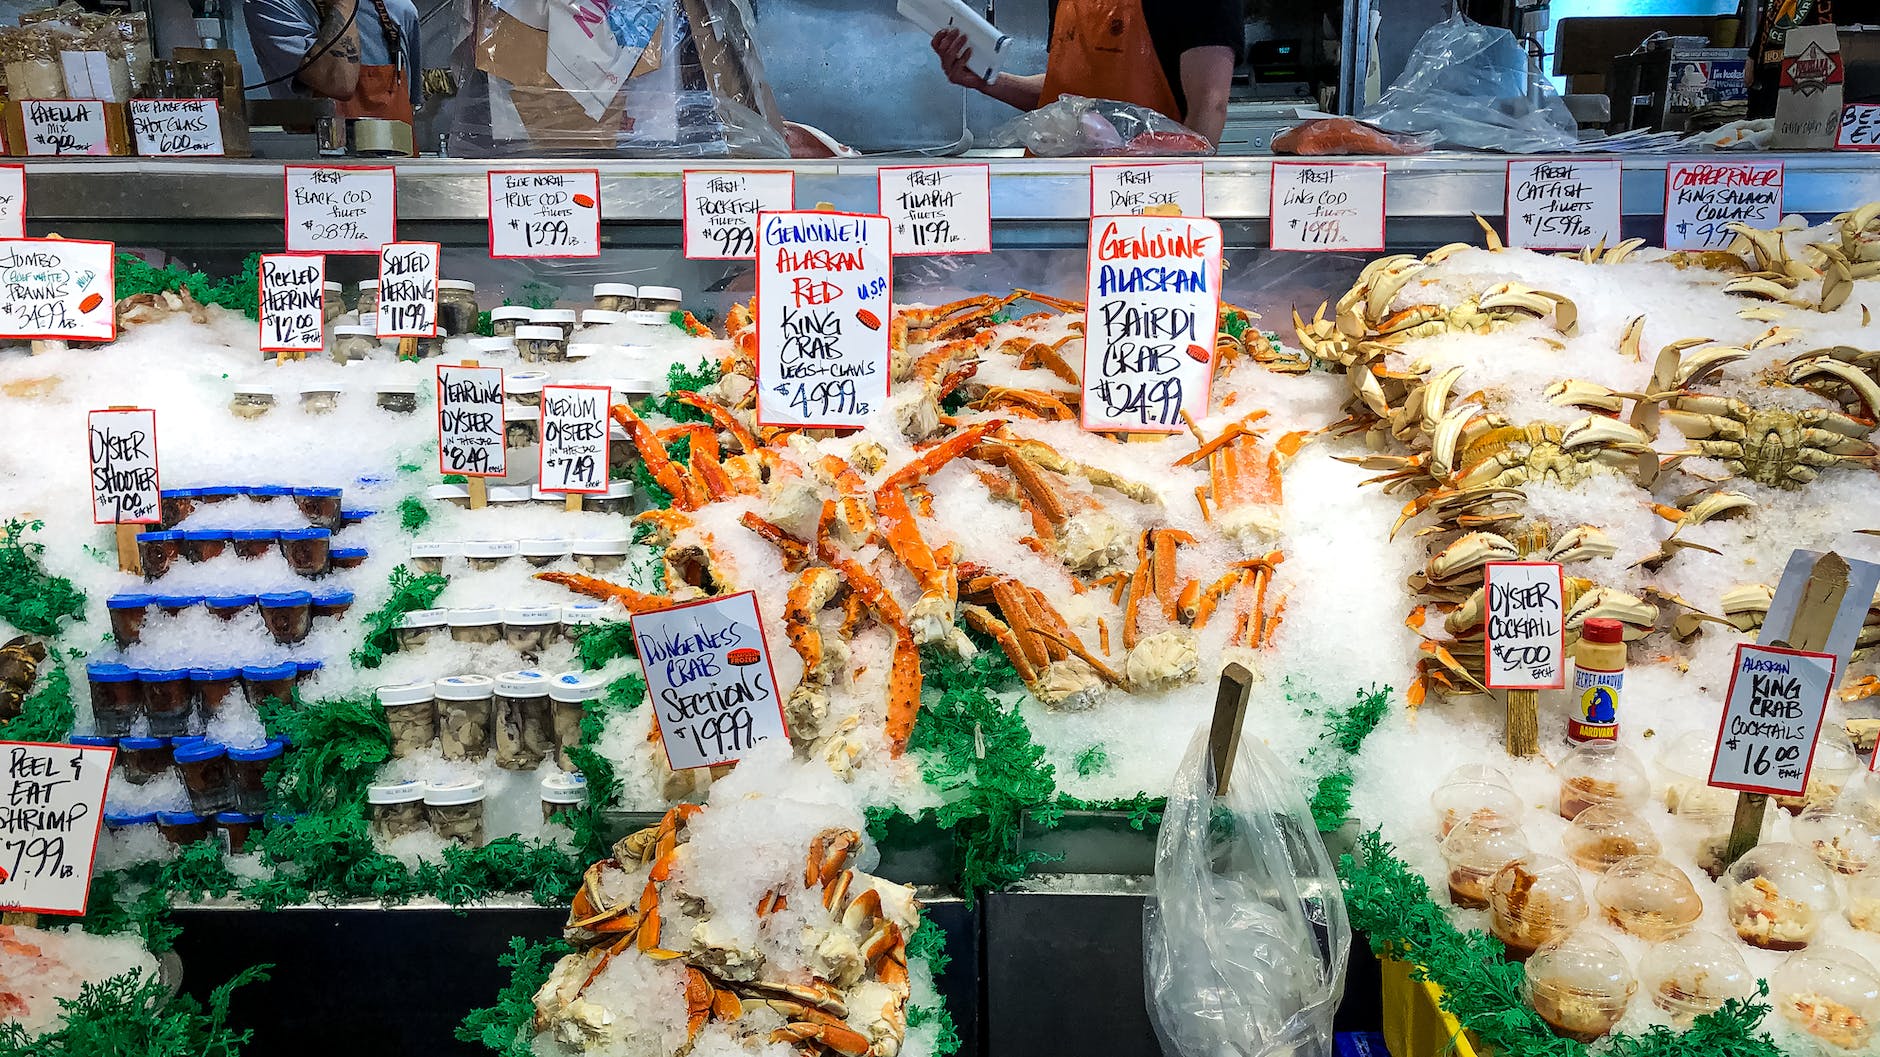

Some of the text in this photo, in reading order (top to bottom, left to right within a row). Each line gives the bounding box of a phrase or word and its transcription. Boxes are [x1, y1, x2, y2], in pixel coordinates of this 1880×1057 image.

[31, 100, 92, 126] PAELLA
[134, 115, 208, 135] SHOT GLASS
[1840, 104, 1880, 128] BE
[47, 122, 69, 135] MIX
[311, 169, 351, 184] FRESH
[505, 175, 575, 188] BLUE NORTH
[907, 170, 952, 187] FRESH
[1117, 170, 1154, 186] FRESH
[1297, 169, 1338, 184] FRESH
[1530, 161, 1580, 182] FRESH
[1672, 165, 1782, 191] COPPER RIVER
[295, 187, 372, 206] BLACK COD
[496, 191, 536, 208] TRUE
[539, 190, 568, 206] COD
[896, 189, 961, 210] TILAPIA
[1110, 190, 1180, 210] DOVER SOLE
[1283, 187, 1347, 206] LING COD
[1517, 181, 1592, 202] CATFISH
[1678, 186, 1780, 205] KING SALMON
[696, 196, 766, 216] ROCKFISH
[1696, 204, 1768, 221] COLLARS
[895, 220, 949, 246] $11.99
[1522, 213, 1583, 237] $15.99
[702, 227, 754, 256] $9.99
[1098, 221, 1214, 261] GENUINE
[0, 246, 61, 269] JUMBO
[383, 248, 430, 276] SALTED
[776, 247, 865, 273] ALASKAN
[262, 261, 320, 288] PICKLED
[1097, 259, 1207, 297] ALASKAN
[5, 282, 69, 302] PRAWNS
[260, 288, 322, 313] HERRING
[380, 277, 434, 303] HERRING
[790, 277, 844, 309] RED
[780, 306, 842, 339] KING
[1099, 300, 1196, 342] BAIRDI
[780, 335, 843, 364] CRAB
[1102, 342, 1181, 378] CRAB
[438, 372, 504, 405] YEARLING
[773, 379, 856, 418] $49.99
[1089, 377, 1182, 425] $24.99
[440, 407, 503, 434] OYSTER
[546, 419, 604, 450] OYSTERS
[90, 425, 149, 471] OYSTER
[443, 446, 489, 473] $8.49
[93, 463, 159, 494] SHOOTER
[546, 455, 595, 485] $7.49
[96, 493, 142, 524] $7.00
[1489, 581, 1559, 618] OYSTER
[1488, 613, 1560, 641] COCKTAIL
[638, 616, 742, 667] DUNGENESS
[1492, 643, 1551, 671] $5.00
[1742, 656, 1790, 675] ALASKAN
[666, 652, 721, 689] CRAB
[661, 668, 770, 723] SECTIONS
[1751, 674, 1802, 700] KING
[1749, 696, 1803, 719] CRAB
[673, 706, 753, 758] $19.99
[1579, 725, 1615, 738] AARDVARK
[1731, 715, 1805, 740] COCKTAILS
[9, 747, 61, 779] PEEL
[1725, 736, 1803, 779] $16.00 EACH
[8, 780, 72, 806] EAT
[0, 802, 88, 834] SHRIMP
[0, 836, 65, 882] 7.99
